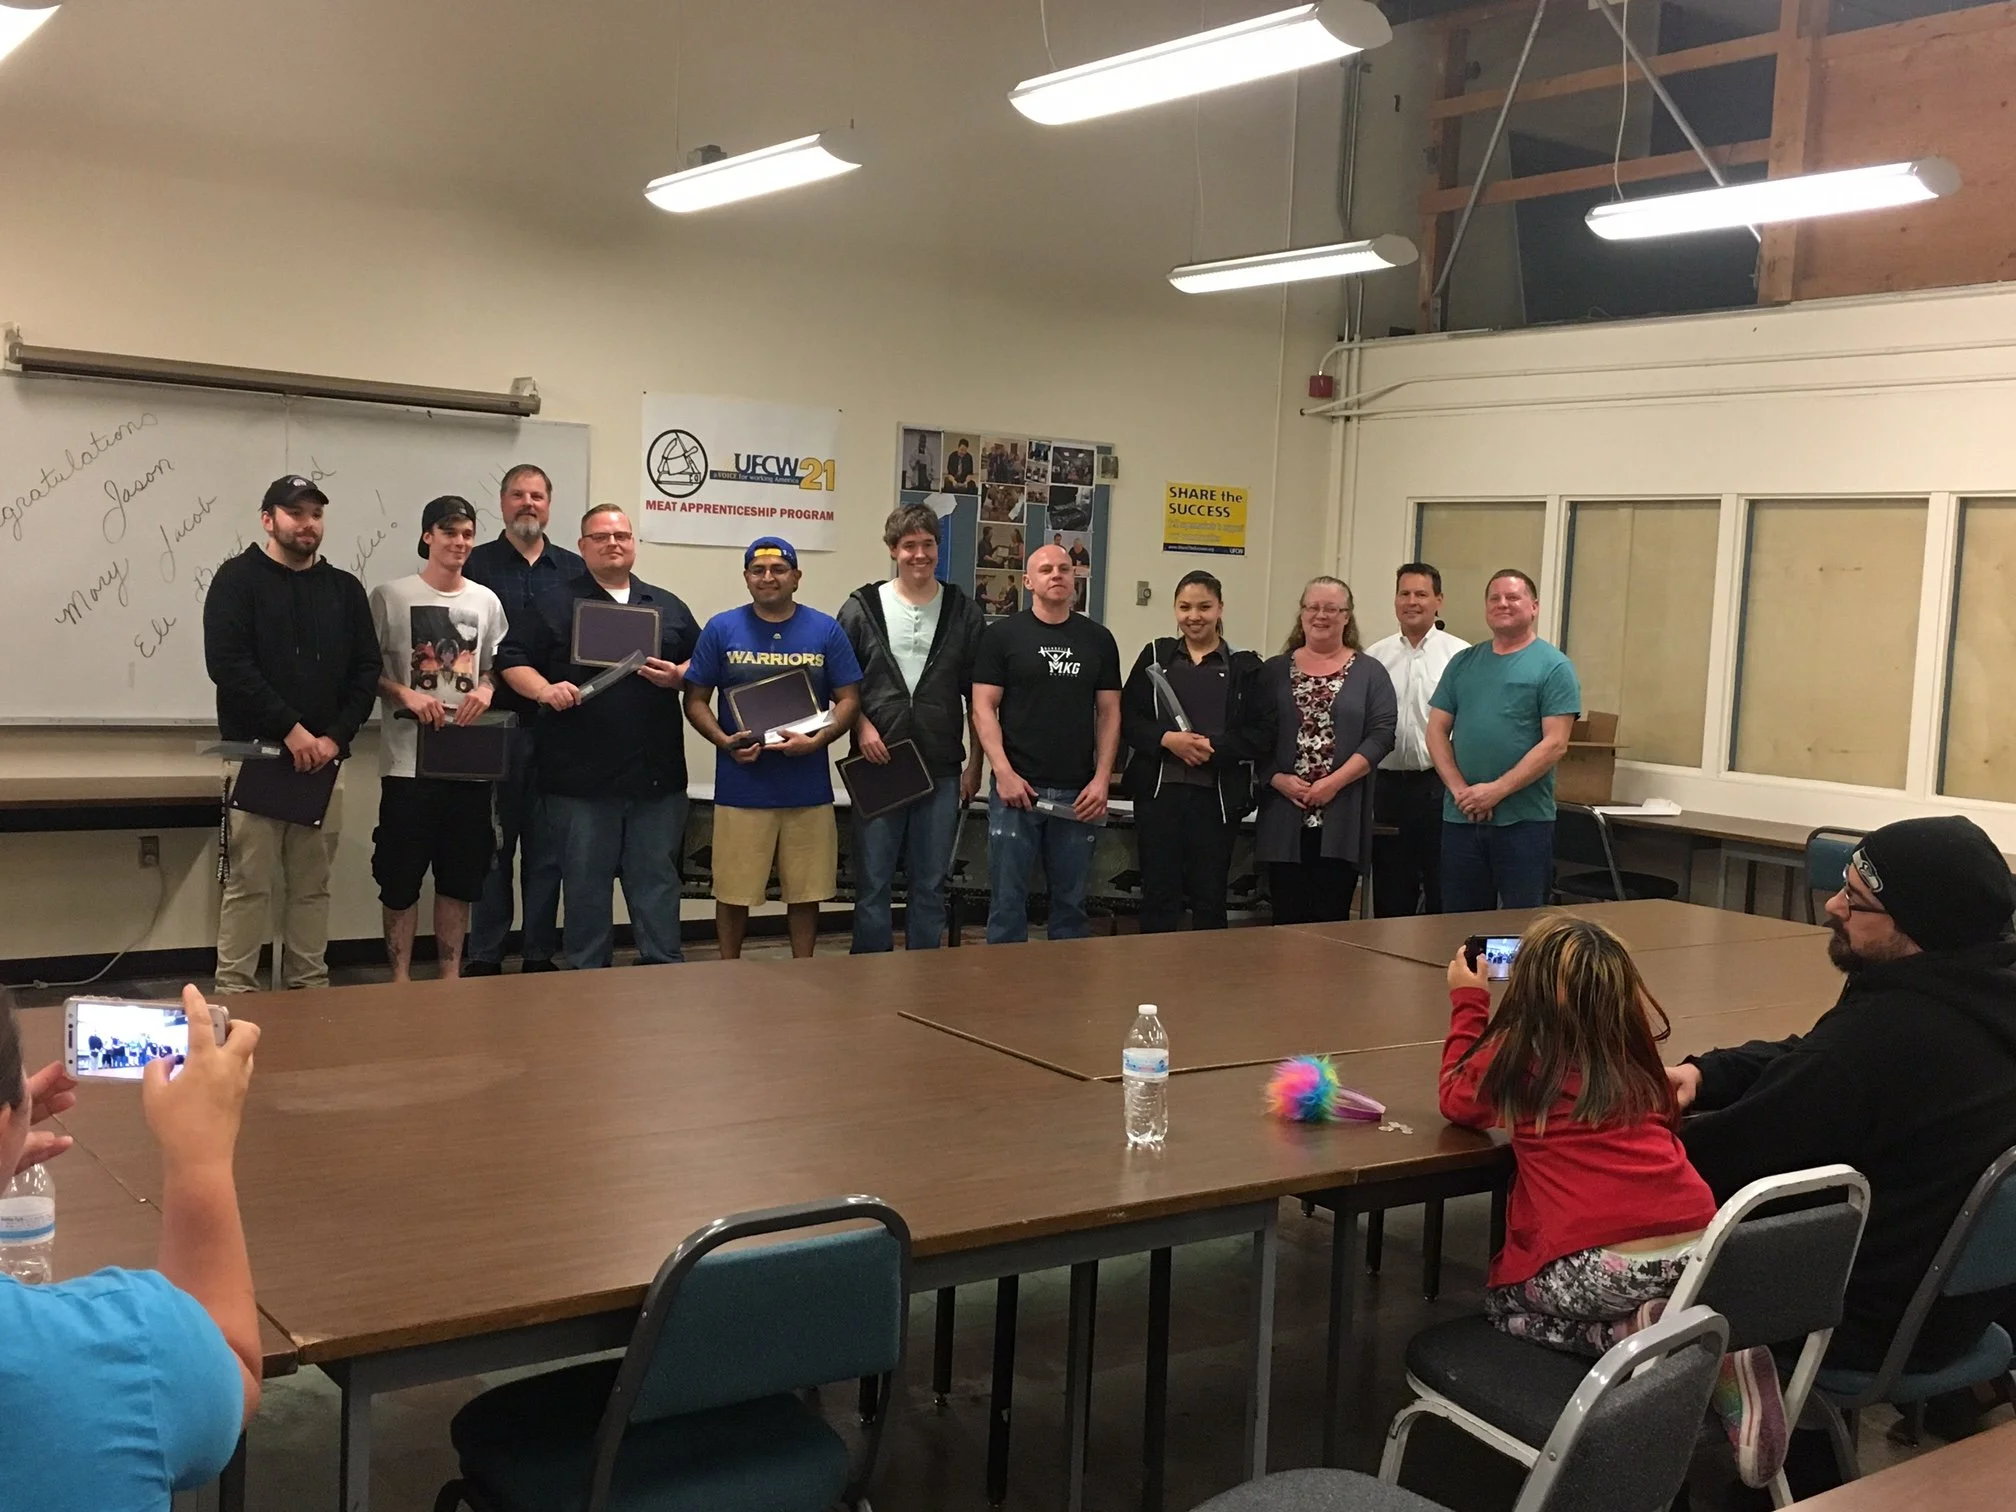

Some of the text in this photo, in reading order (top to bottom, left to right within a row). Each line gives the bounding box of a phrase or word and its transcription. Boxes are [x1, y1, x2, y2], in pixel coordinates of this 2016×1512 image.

[0, 413, 158, 541] gratulations
[734, 453, 836, 491] UFCW 21
[749, 474, 773, 483] working
[103, 458, 175, 544] Jason
[1169, 486, 1243, 503] SHARE the
[645, 500, 834, 521] MEAT APPRENTICESHIP PROGRAM
[1169, 503, 1230, 517] SUCCESS
[160, 496, 217, 583] Jacob
[55, 558, 129, 624] Mary
[726, 650, 825, 667] WARRIORS
[1048, 660, 1081, 674] MKG
